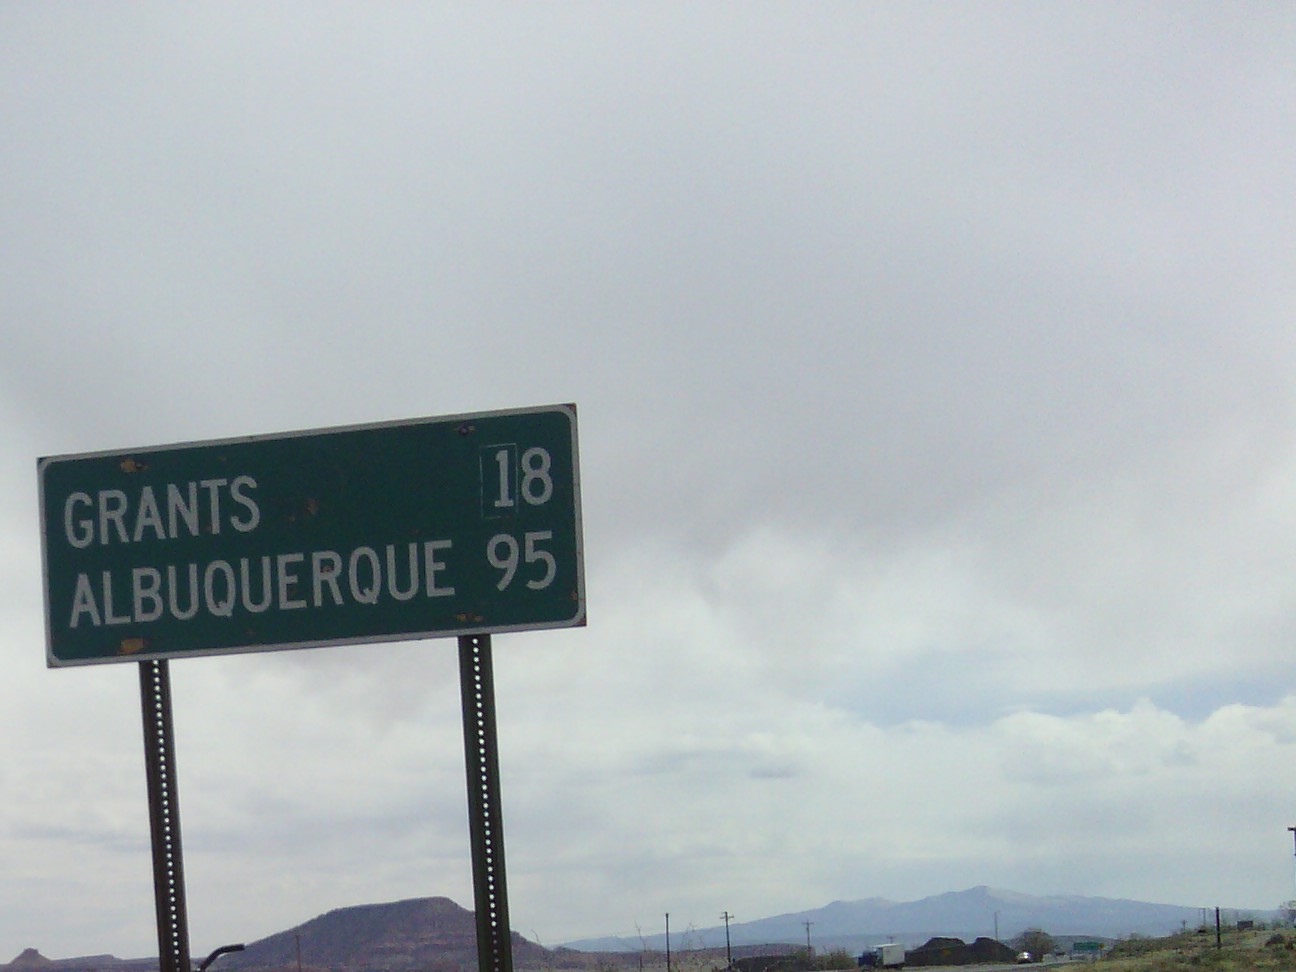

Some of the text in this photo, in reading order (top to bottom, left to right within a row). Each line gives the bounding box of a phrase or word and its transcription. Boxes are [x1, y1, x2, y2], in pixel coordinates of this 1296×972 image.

[64, 446, 553, 548] GRANTS 18
[69, 530, 557, 629] ALBUQUERQUE 95
